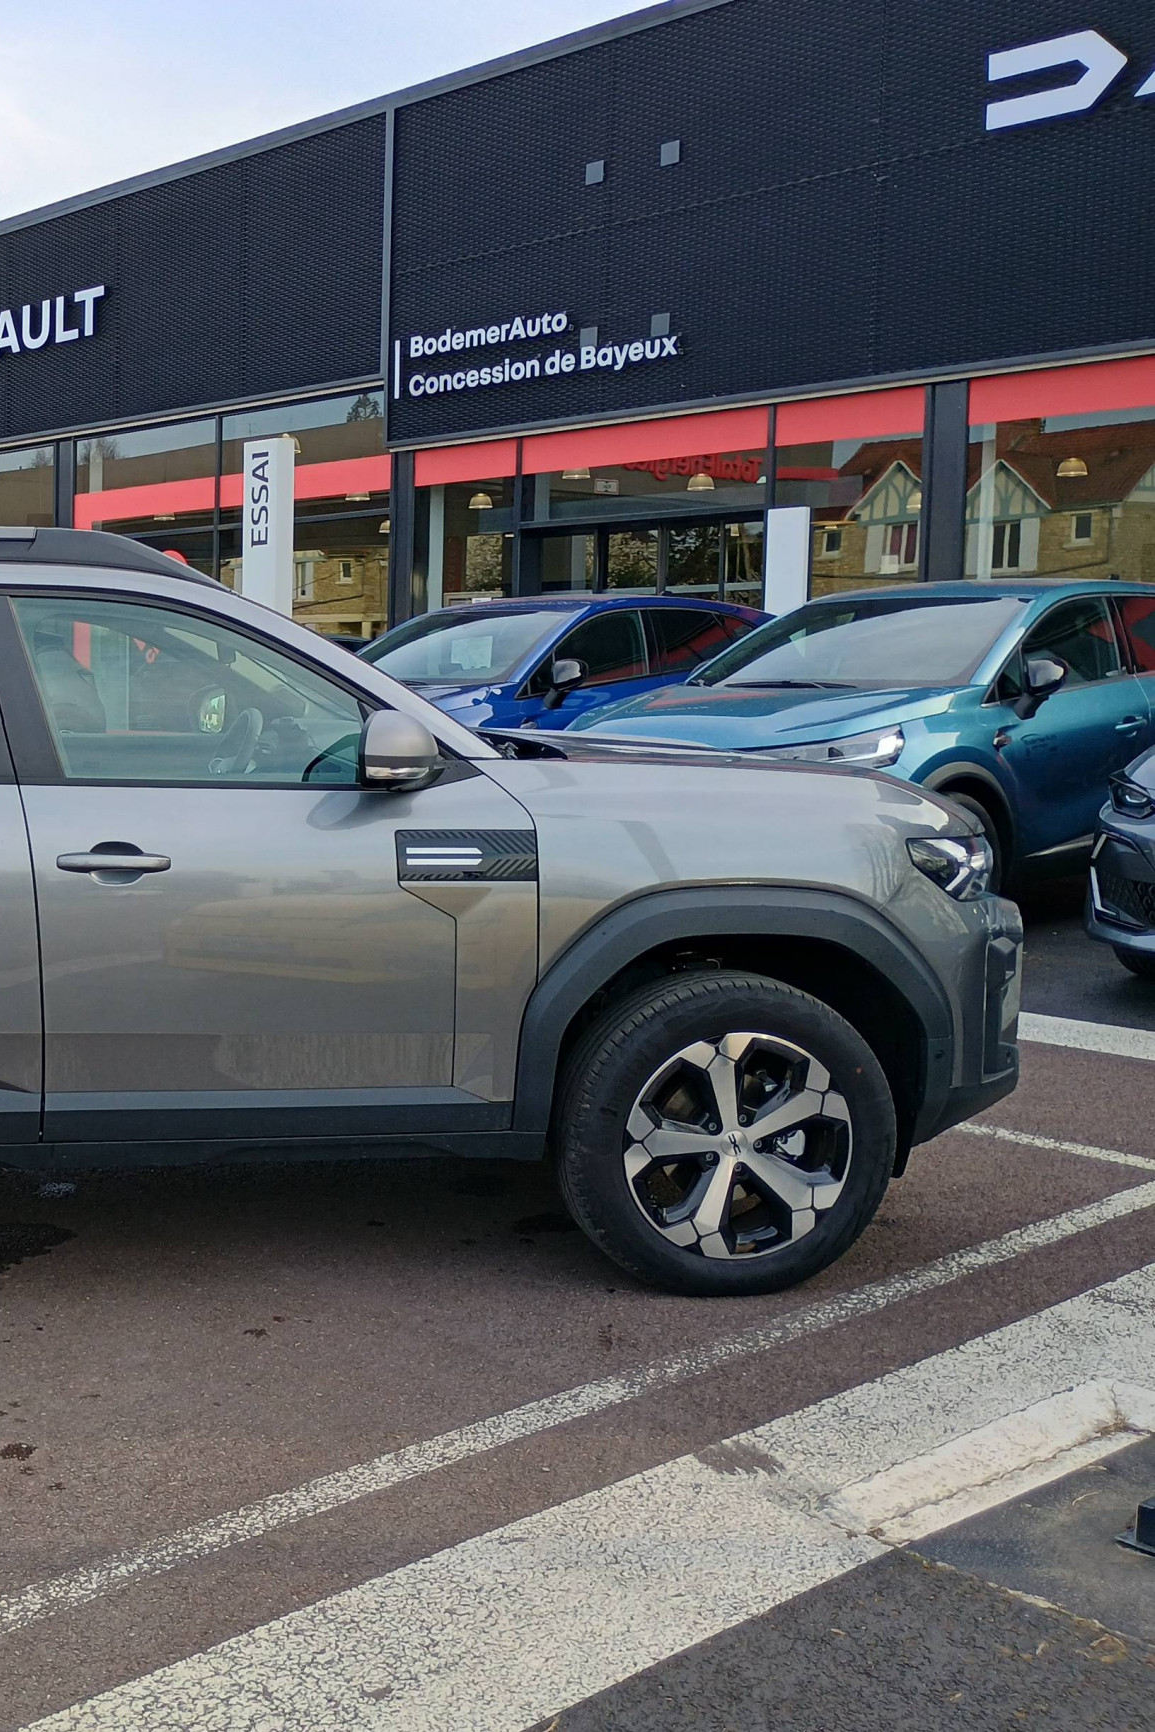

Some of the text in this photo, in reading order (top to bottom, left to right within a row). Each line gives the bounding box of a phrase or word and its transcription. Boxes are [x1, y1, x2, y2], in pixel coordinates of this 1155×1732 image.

[986, 29, 1155, 131] D
[409, 312, 568, 358] BodemerAuto
[409, 336, 678, 397] Concession de Bayeux
[251, 451, 269, 548] ESSAI
